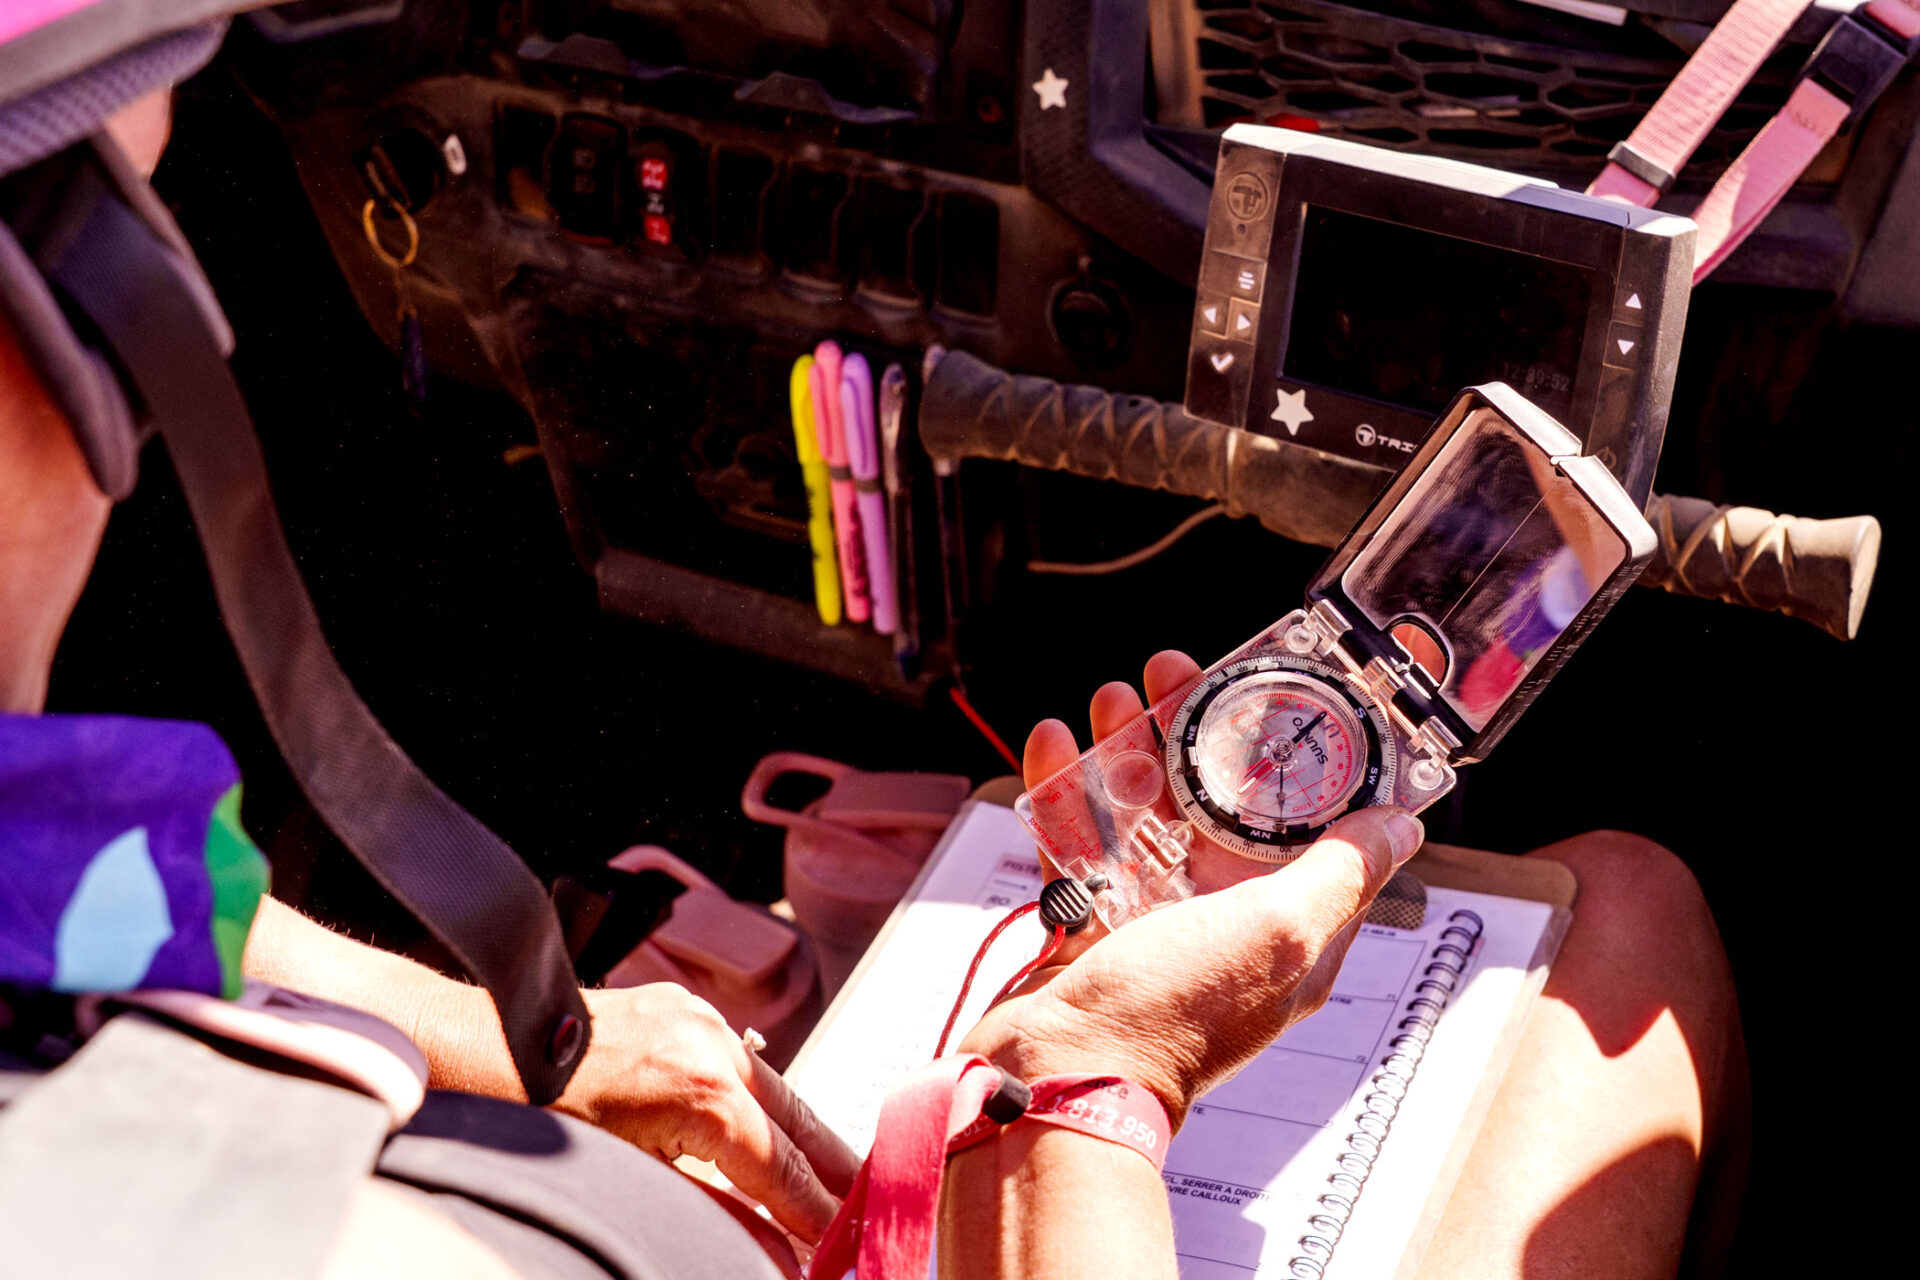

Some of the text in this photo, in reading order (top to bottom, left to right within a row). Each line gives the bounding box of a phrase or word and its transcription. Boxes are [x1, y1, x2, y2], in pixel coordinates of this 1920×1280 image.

[1377, 434, 1418, 453] TRI
[1354, 706, 1367, 719] S
[1186, 724, 1198, 741] NE
[1367, 766, 1379, 786] SW
[1196, 788, 1209, 802] N
[1249, 829, 1271, 840] NW
[1120, 1115, 1157, 1149] 950
[1182, 1178, 1223, 1192] SERRER
[1190, 1189, 1242, 1205] CAILLOUX
